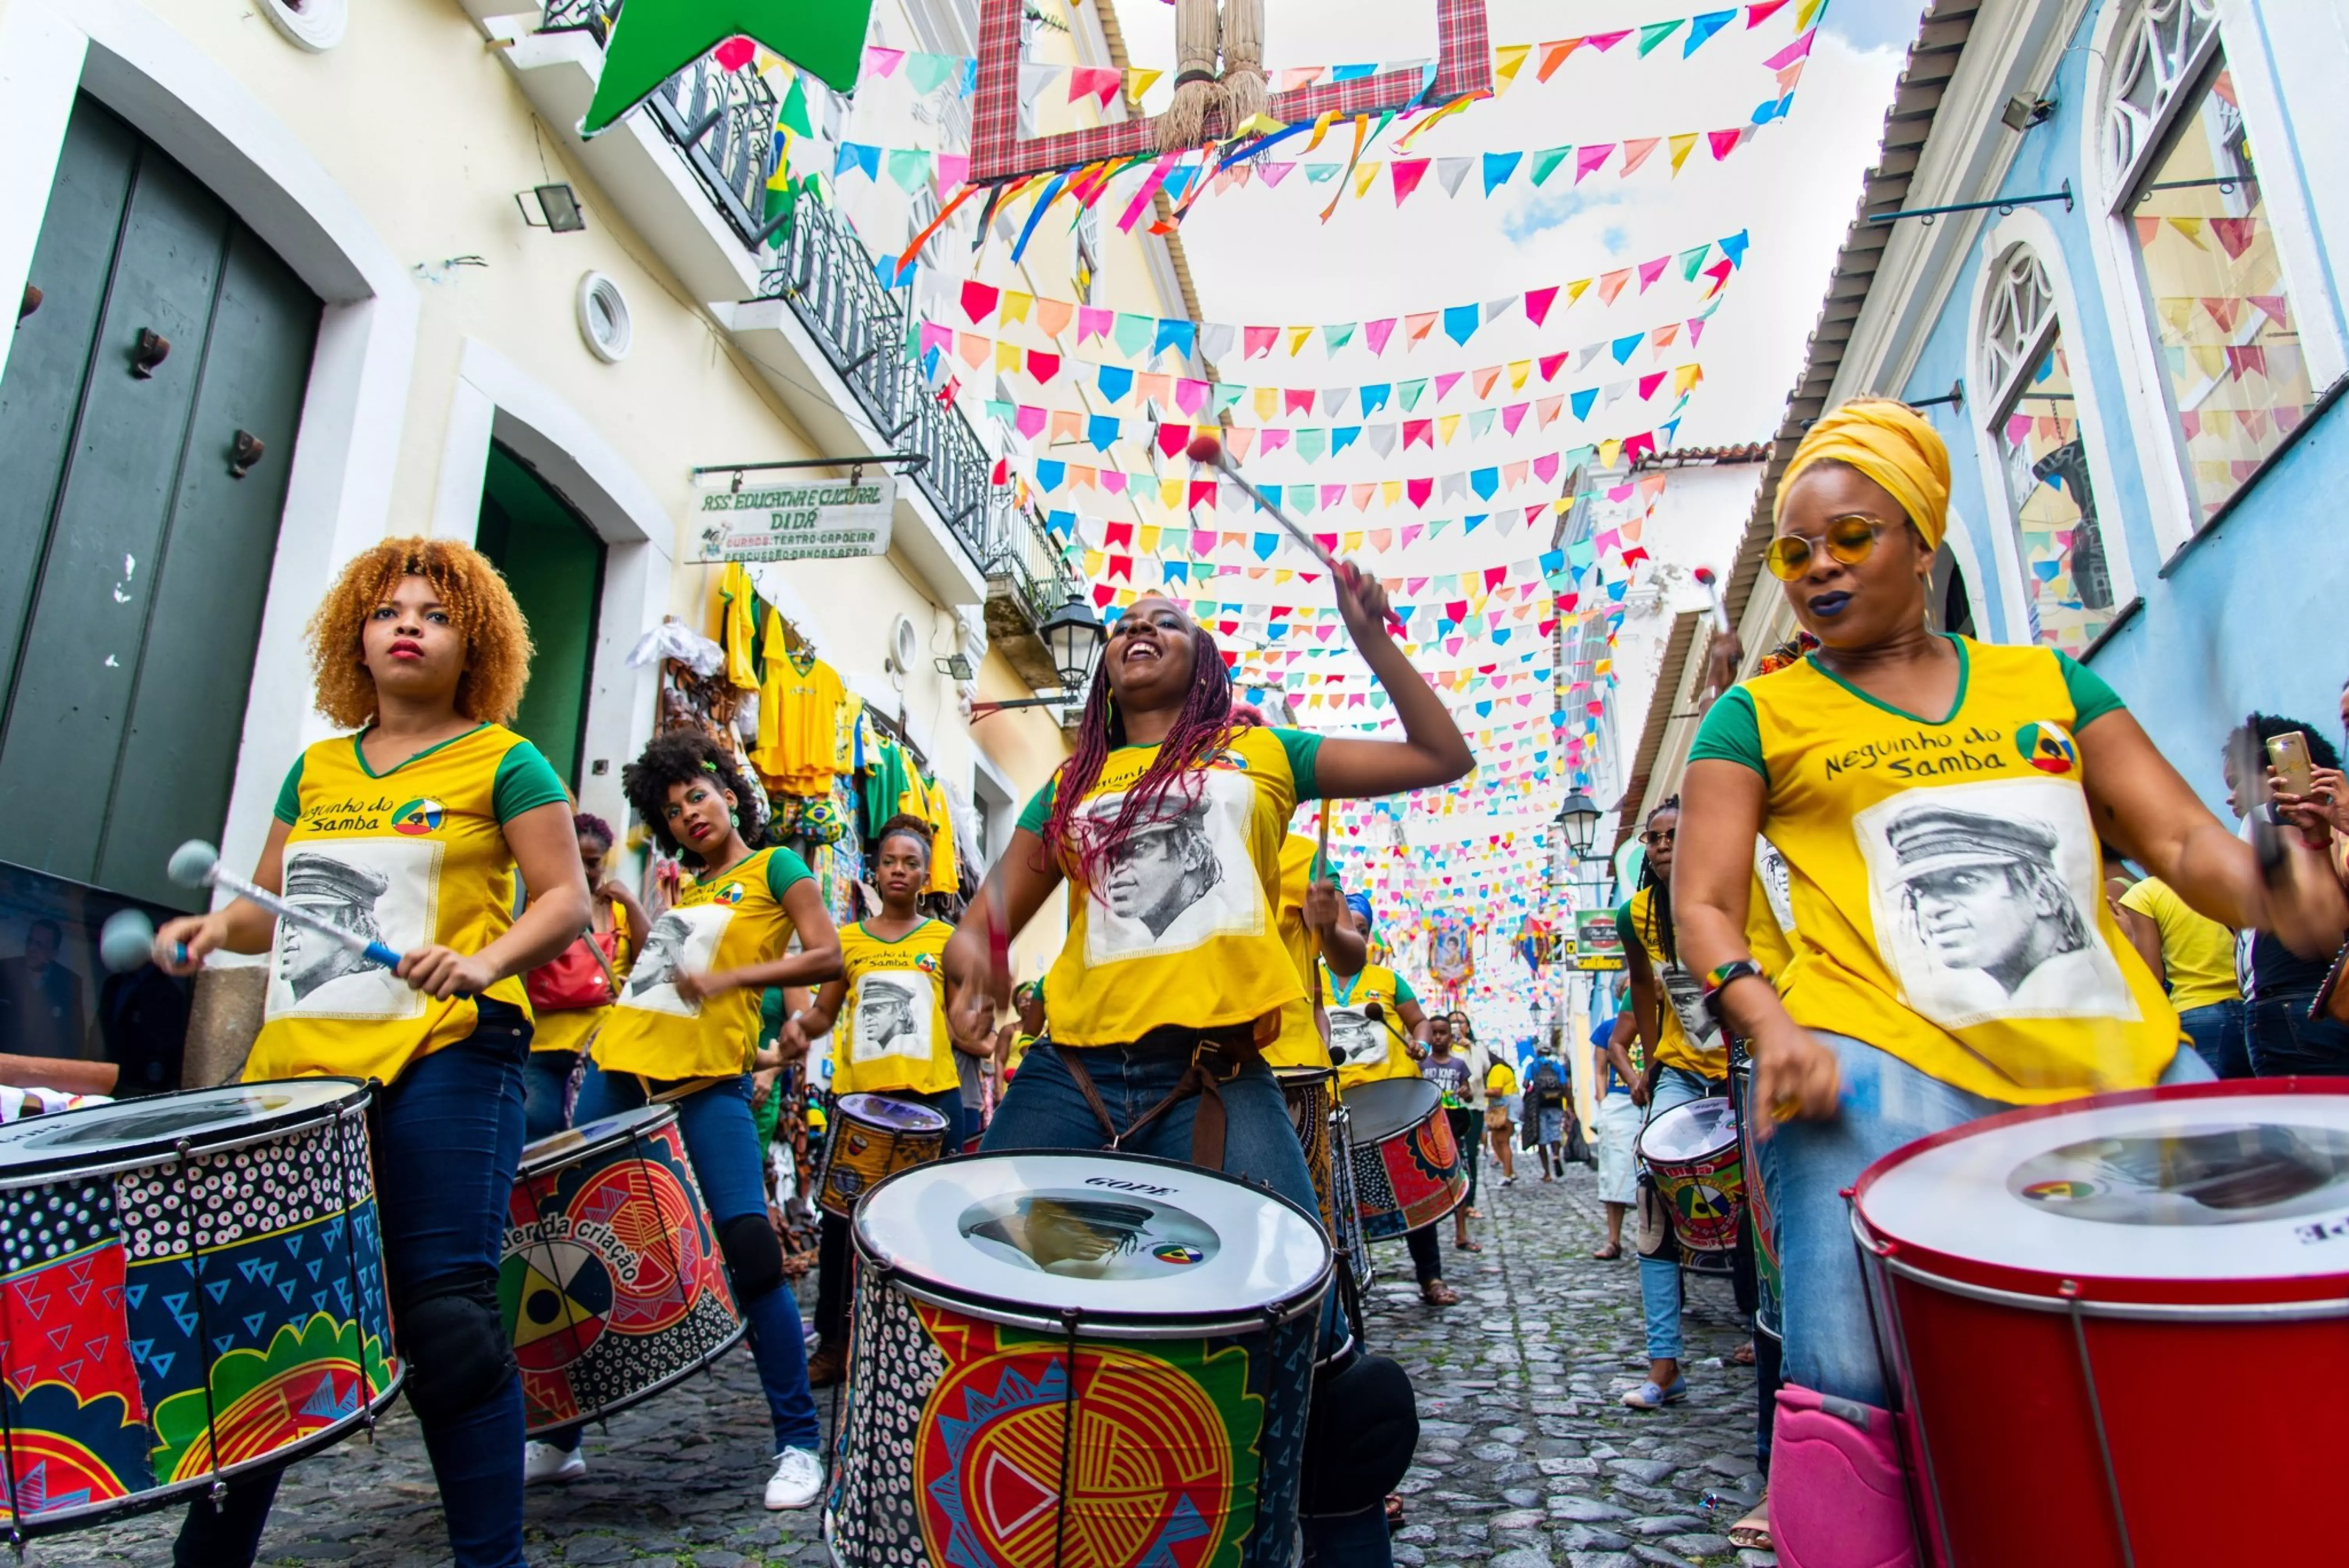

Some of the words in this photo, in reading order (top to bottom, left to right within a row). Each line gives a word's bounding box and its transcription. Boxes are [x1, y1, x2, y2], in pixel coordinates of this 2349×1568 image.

[820, 486, 881, 505] CULTURAL
[1825, 731, 1952, 781] Neguinho
[1964, 727, 2001, 743] do
[367, 796, 394, 812] do
[1084, 1177, 1180, 1196] GOPE
[577, 1221, 637, 1281] criação
